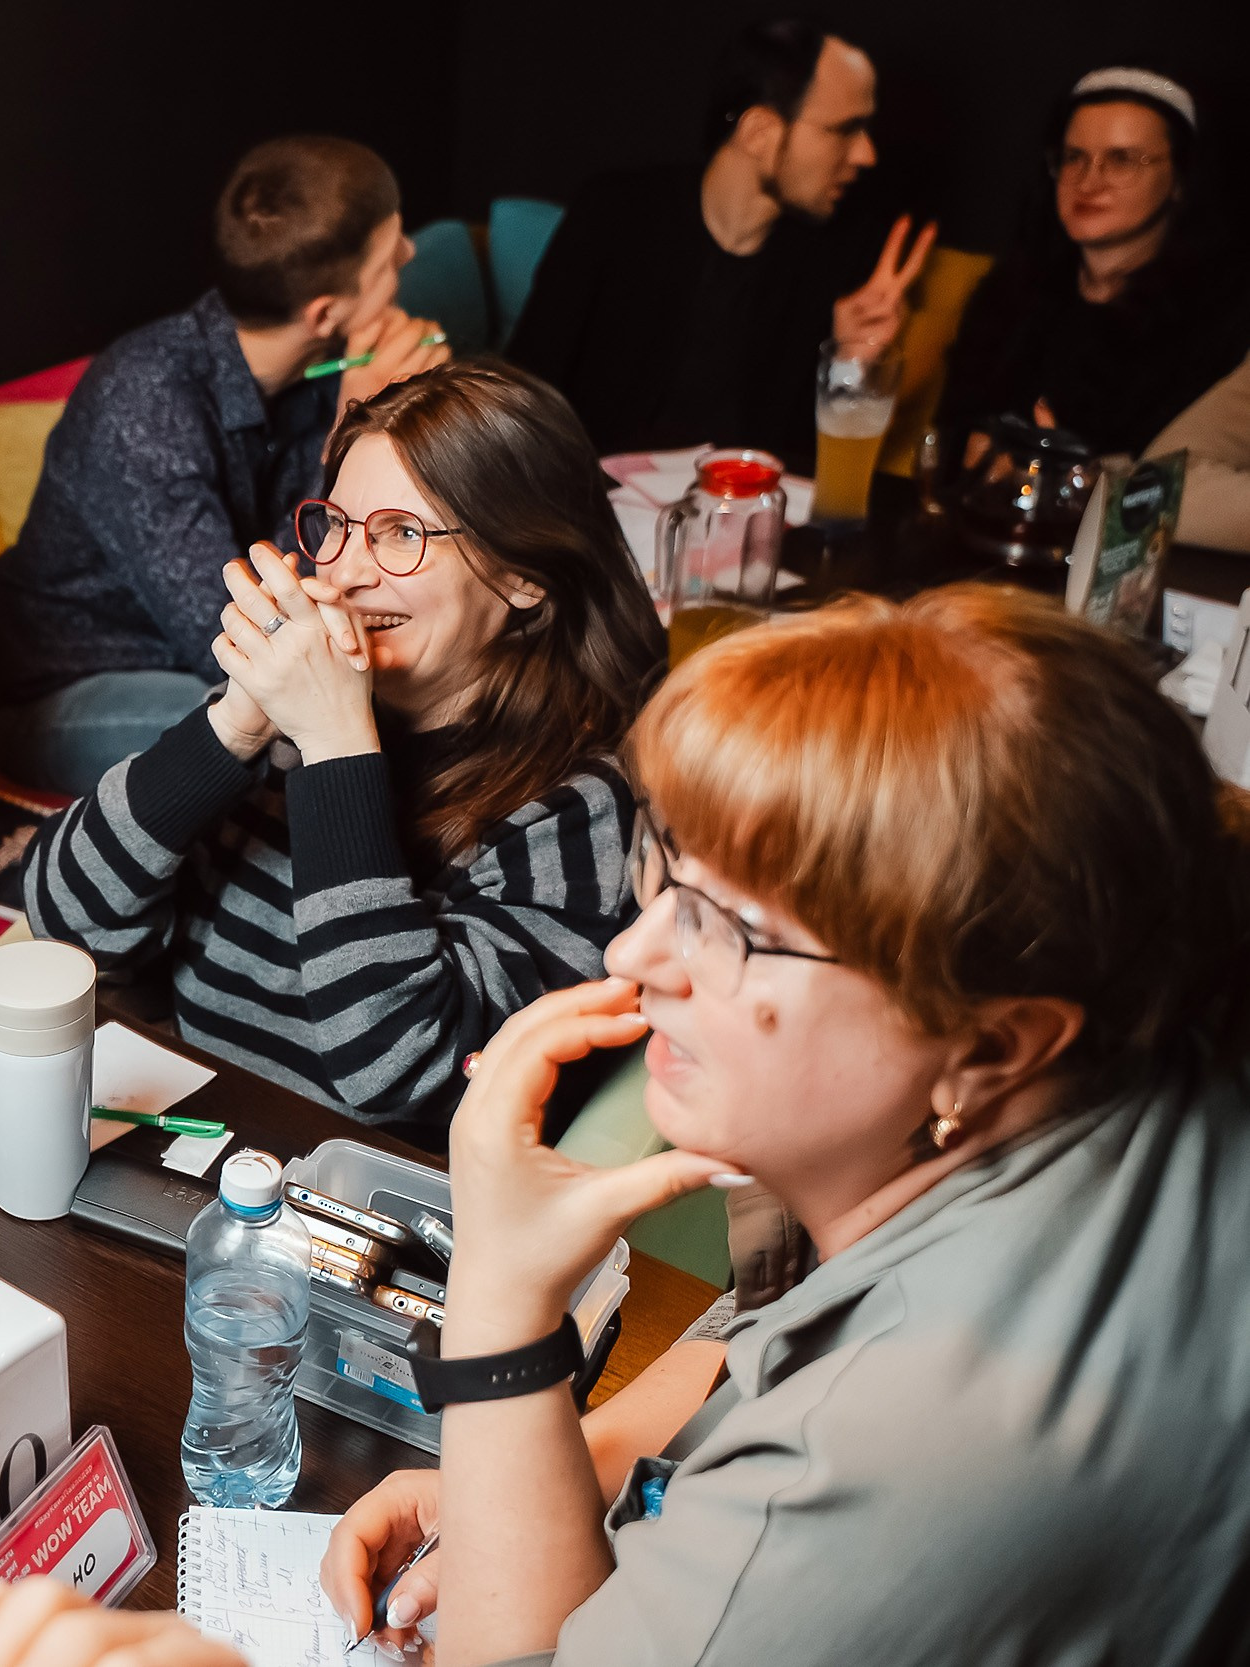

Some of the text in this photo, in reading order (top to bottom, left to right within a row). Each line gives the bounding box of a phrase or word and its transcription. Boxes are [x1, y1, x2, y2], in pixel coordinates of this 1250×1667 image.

[31, 1475, 112, 1568] WOW TEAM
[63, 1473, 100, 1515] my name is
